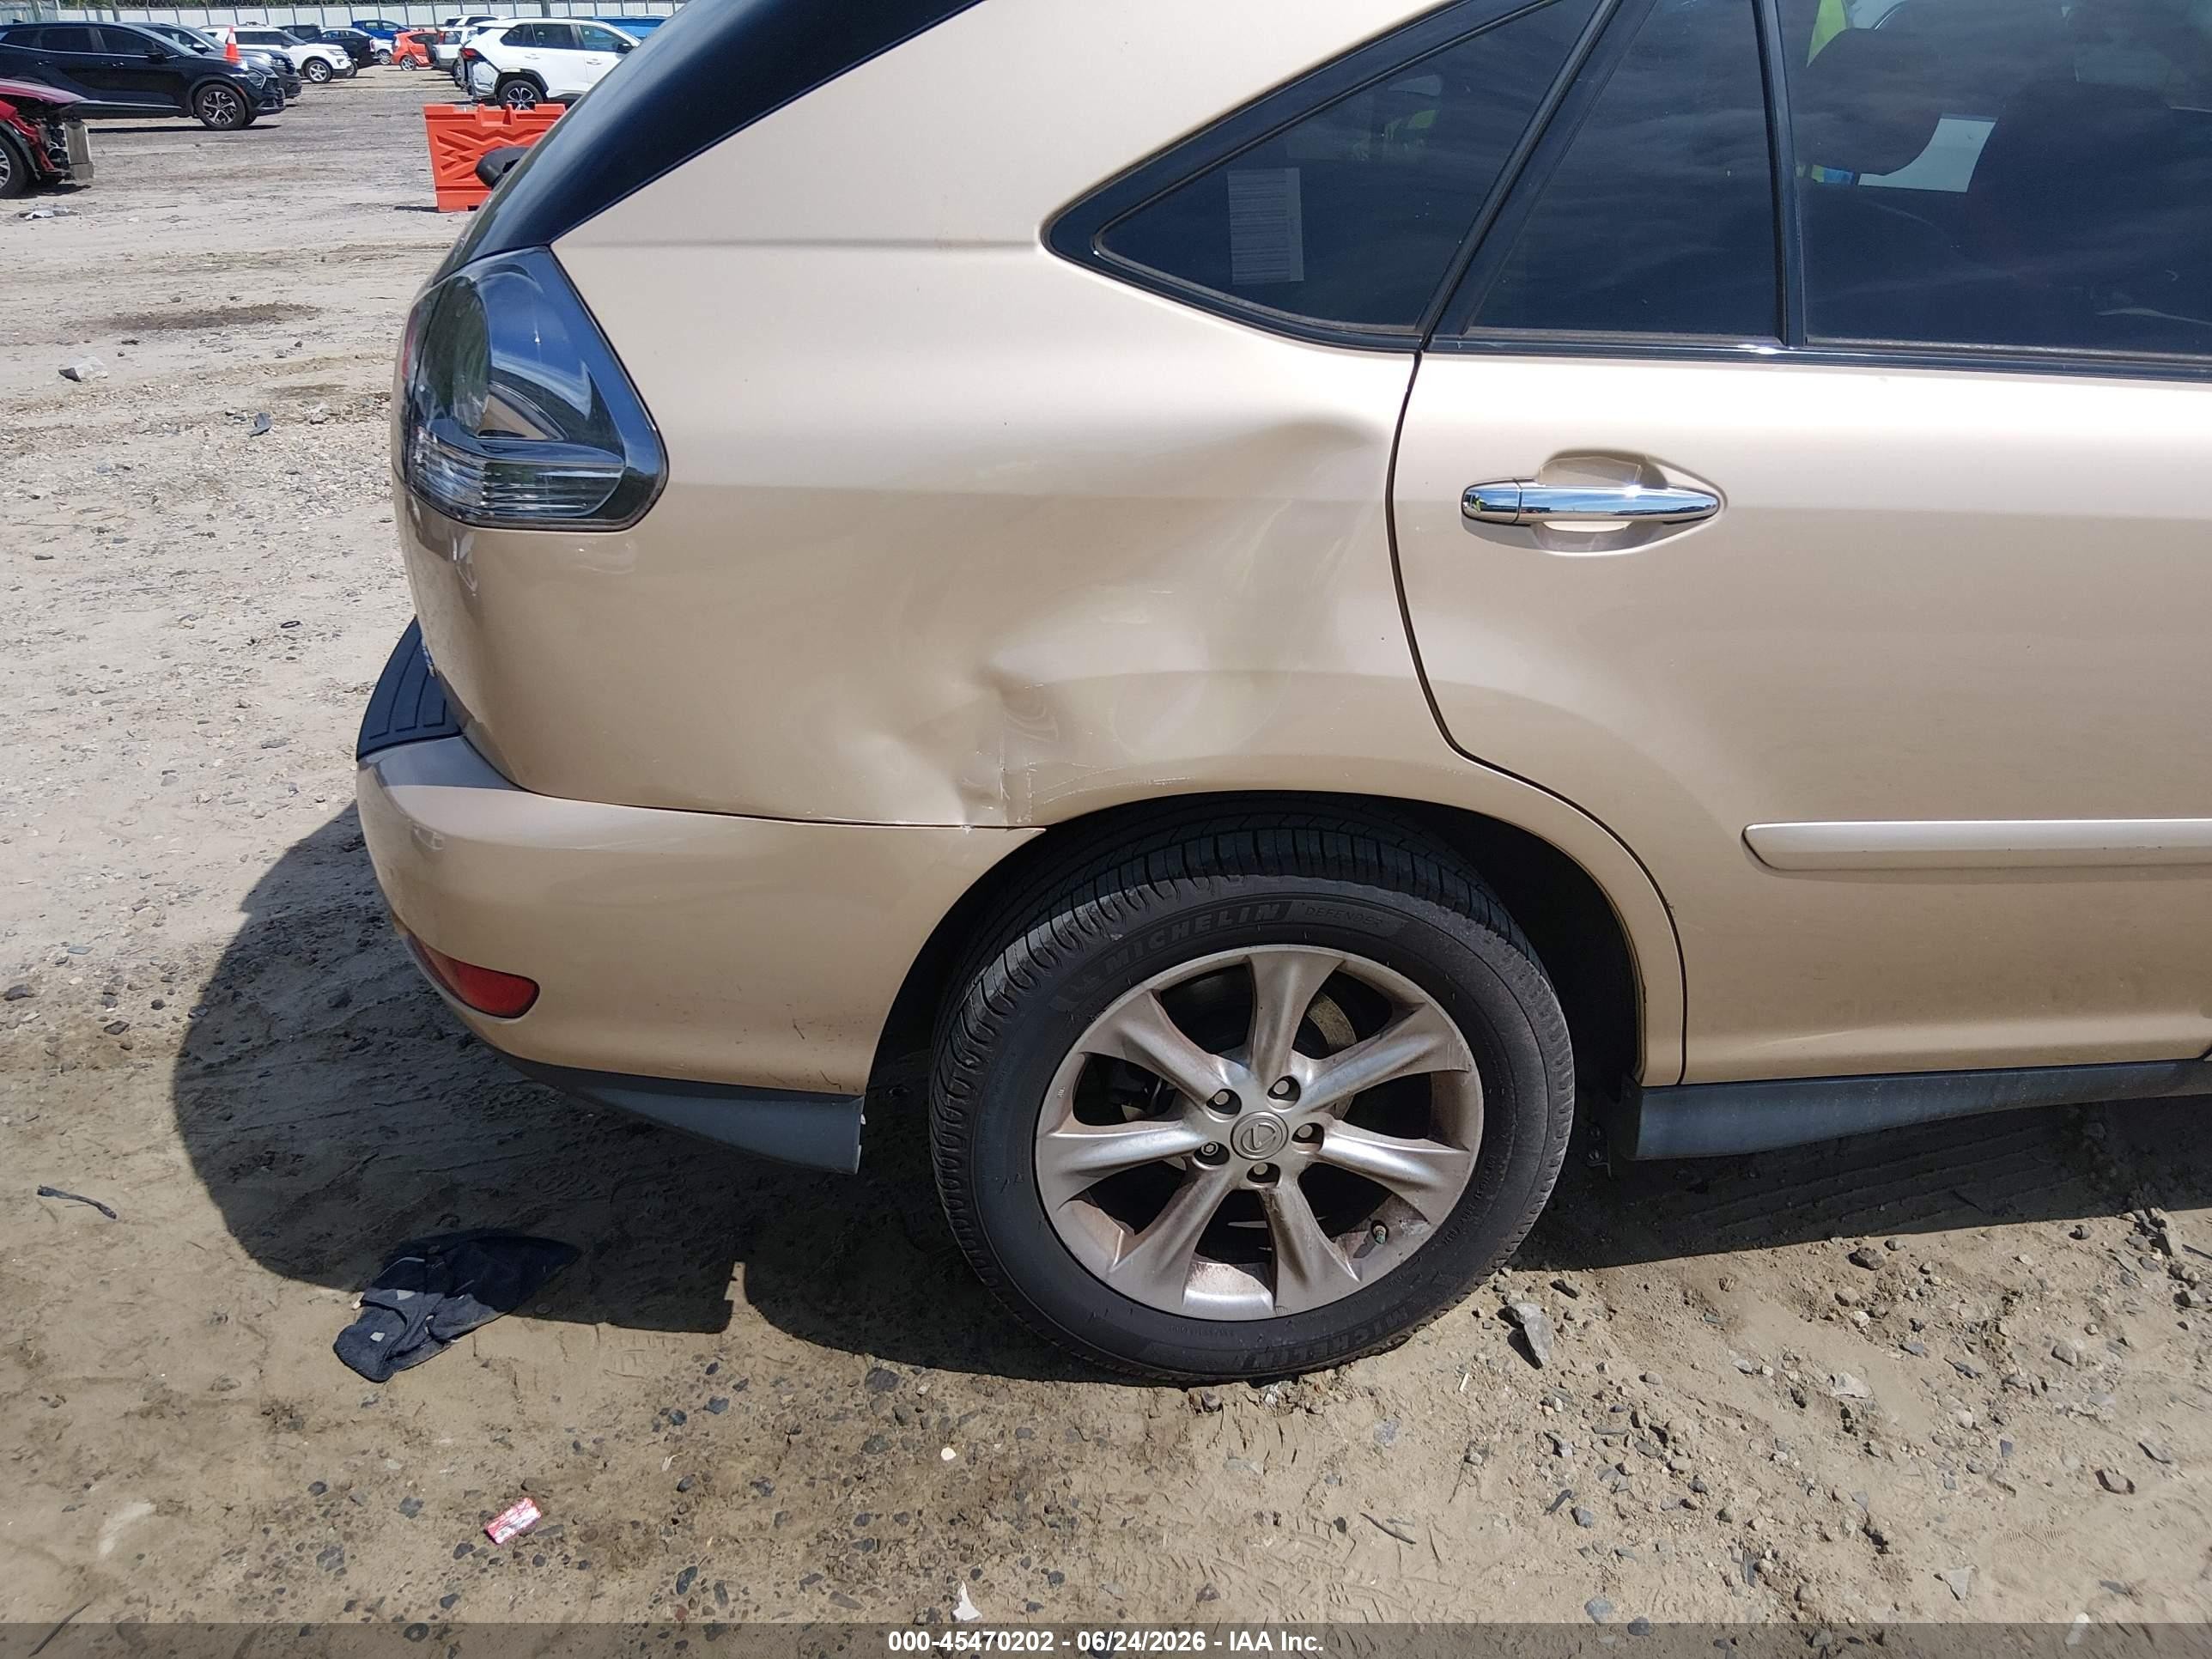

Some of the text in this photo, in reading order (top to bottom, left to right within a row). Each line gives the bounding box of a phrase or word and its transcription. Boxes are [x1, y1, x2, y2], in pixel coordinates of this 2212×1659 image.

[1104, 903, 1383, 975] MICHELIN DEFENDER
[1254, 1306, 1410, 1369] MICHELIN
